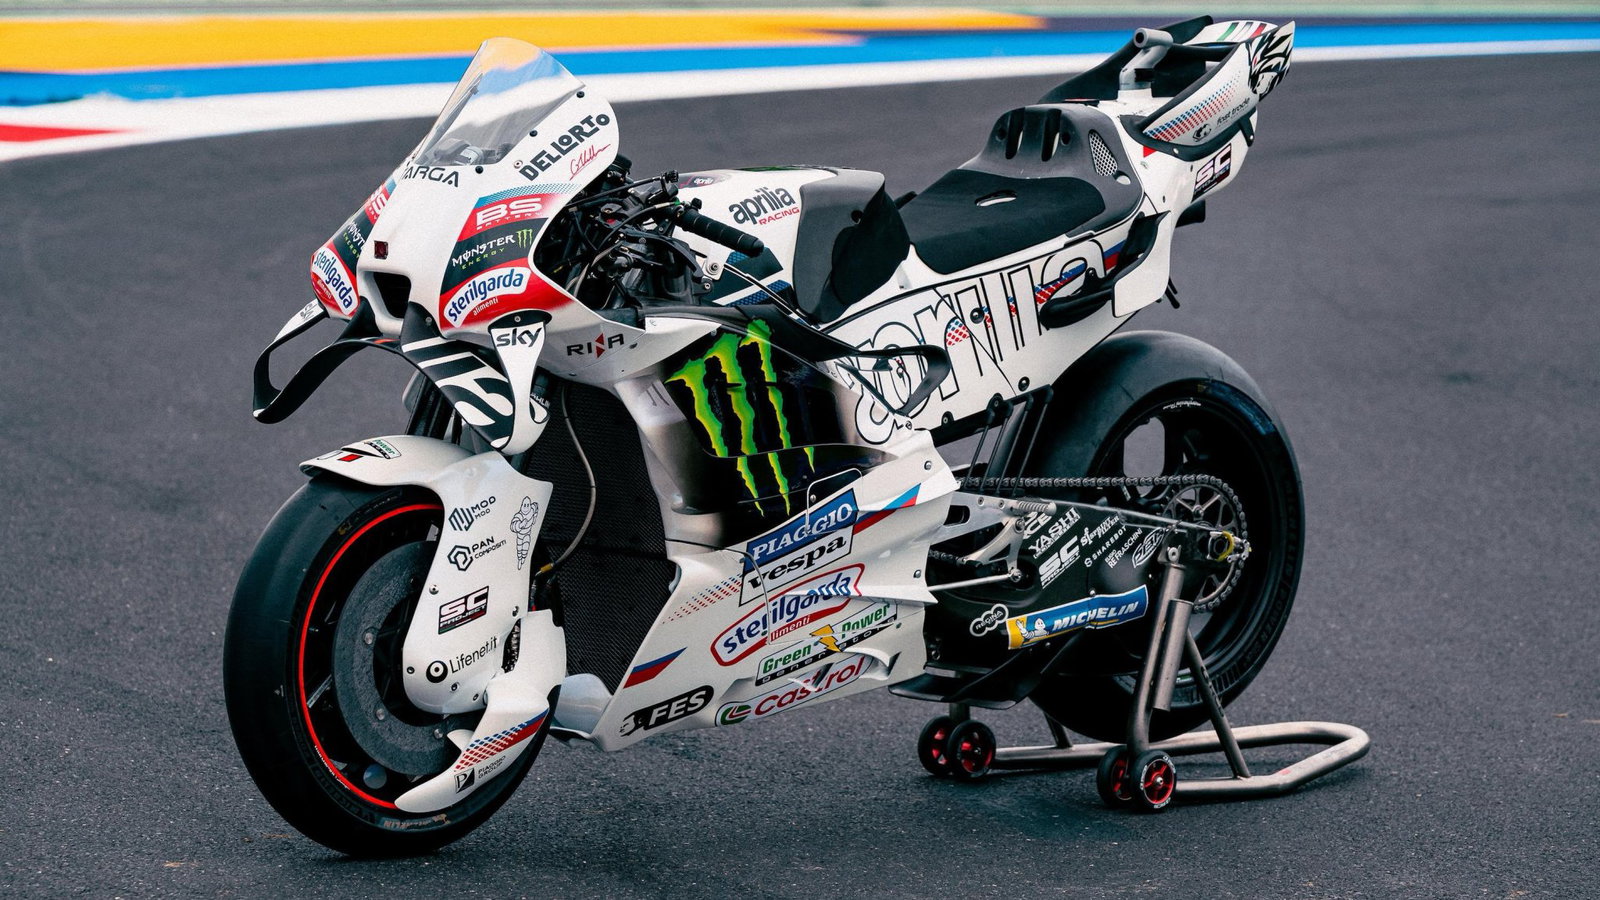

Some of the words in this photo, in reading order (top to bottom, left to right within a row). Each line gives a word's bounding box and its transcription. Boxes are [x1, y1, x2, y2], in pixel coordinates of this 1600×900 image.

[519, 113, 610, 182] DELLORTO
[1195, 145, 1231, 189] SC
[476, 197, 543, 226] BS
[728, 186, 796, 225] aprilia
[758, 206, 800, 226] RACING
[451, 234, 516, 267] MONSTER
[461, 247, 505, 270] ENERGY
[313, 250, 353, 310] sterilgarda
[448, 268, 524, 322] sterilgarda
[472, 295, 499, 316] alimenti
[496, 326, 543, 348] sky
[470, 495, 497, 514] MOD
[474, 508, 491, 520] MOD
[471, 535, 495, 552] PAN
[752, 503, 853, 561] PIAGGIO
[1028, 507, 1080, 555] YASHI
[1092, 525, 1127, 561] SHAREBOT
[747, 535, 847, 589] vespa
[1038, 535, 1080, 582] SC
[440, 587, 489, 621] SC
[723, 572, 851, 654] sterilgarda
[1052, 601, 1139, 632] MICHELIN
[762, 644, 812, 675] Green
[841, 602, 891, 639] Power
[770, 615, 811, 641] limenti
[449, 636, 498, 674] Lifenet.it
[754, 655, 866, 716] Castrol
[648, 690, 707, 726] FES
[478, 755, 506, 774] PIAGGIO
